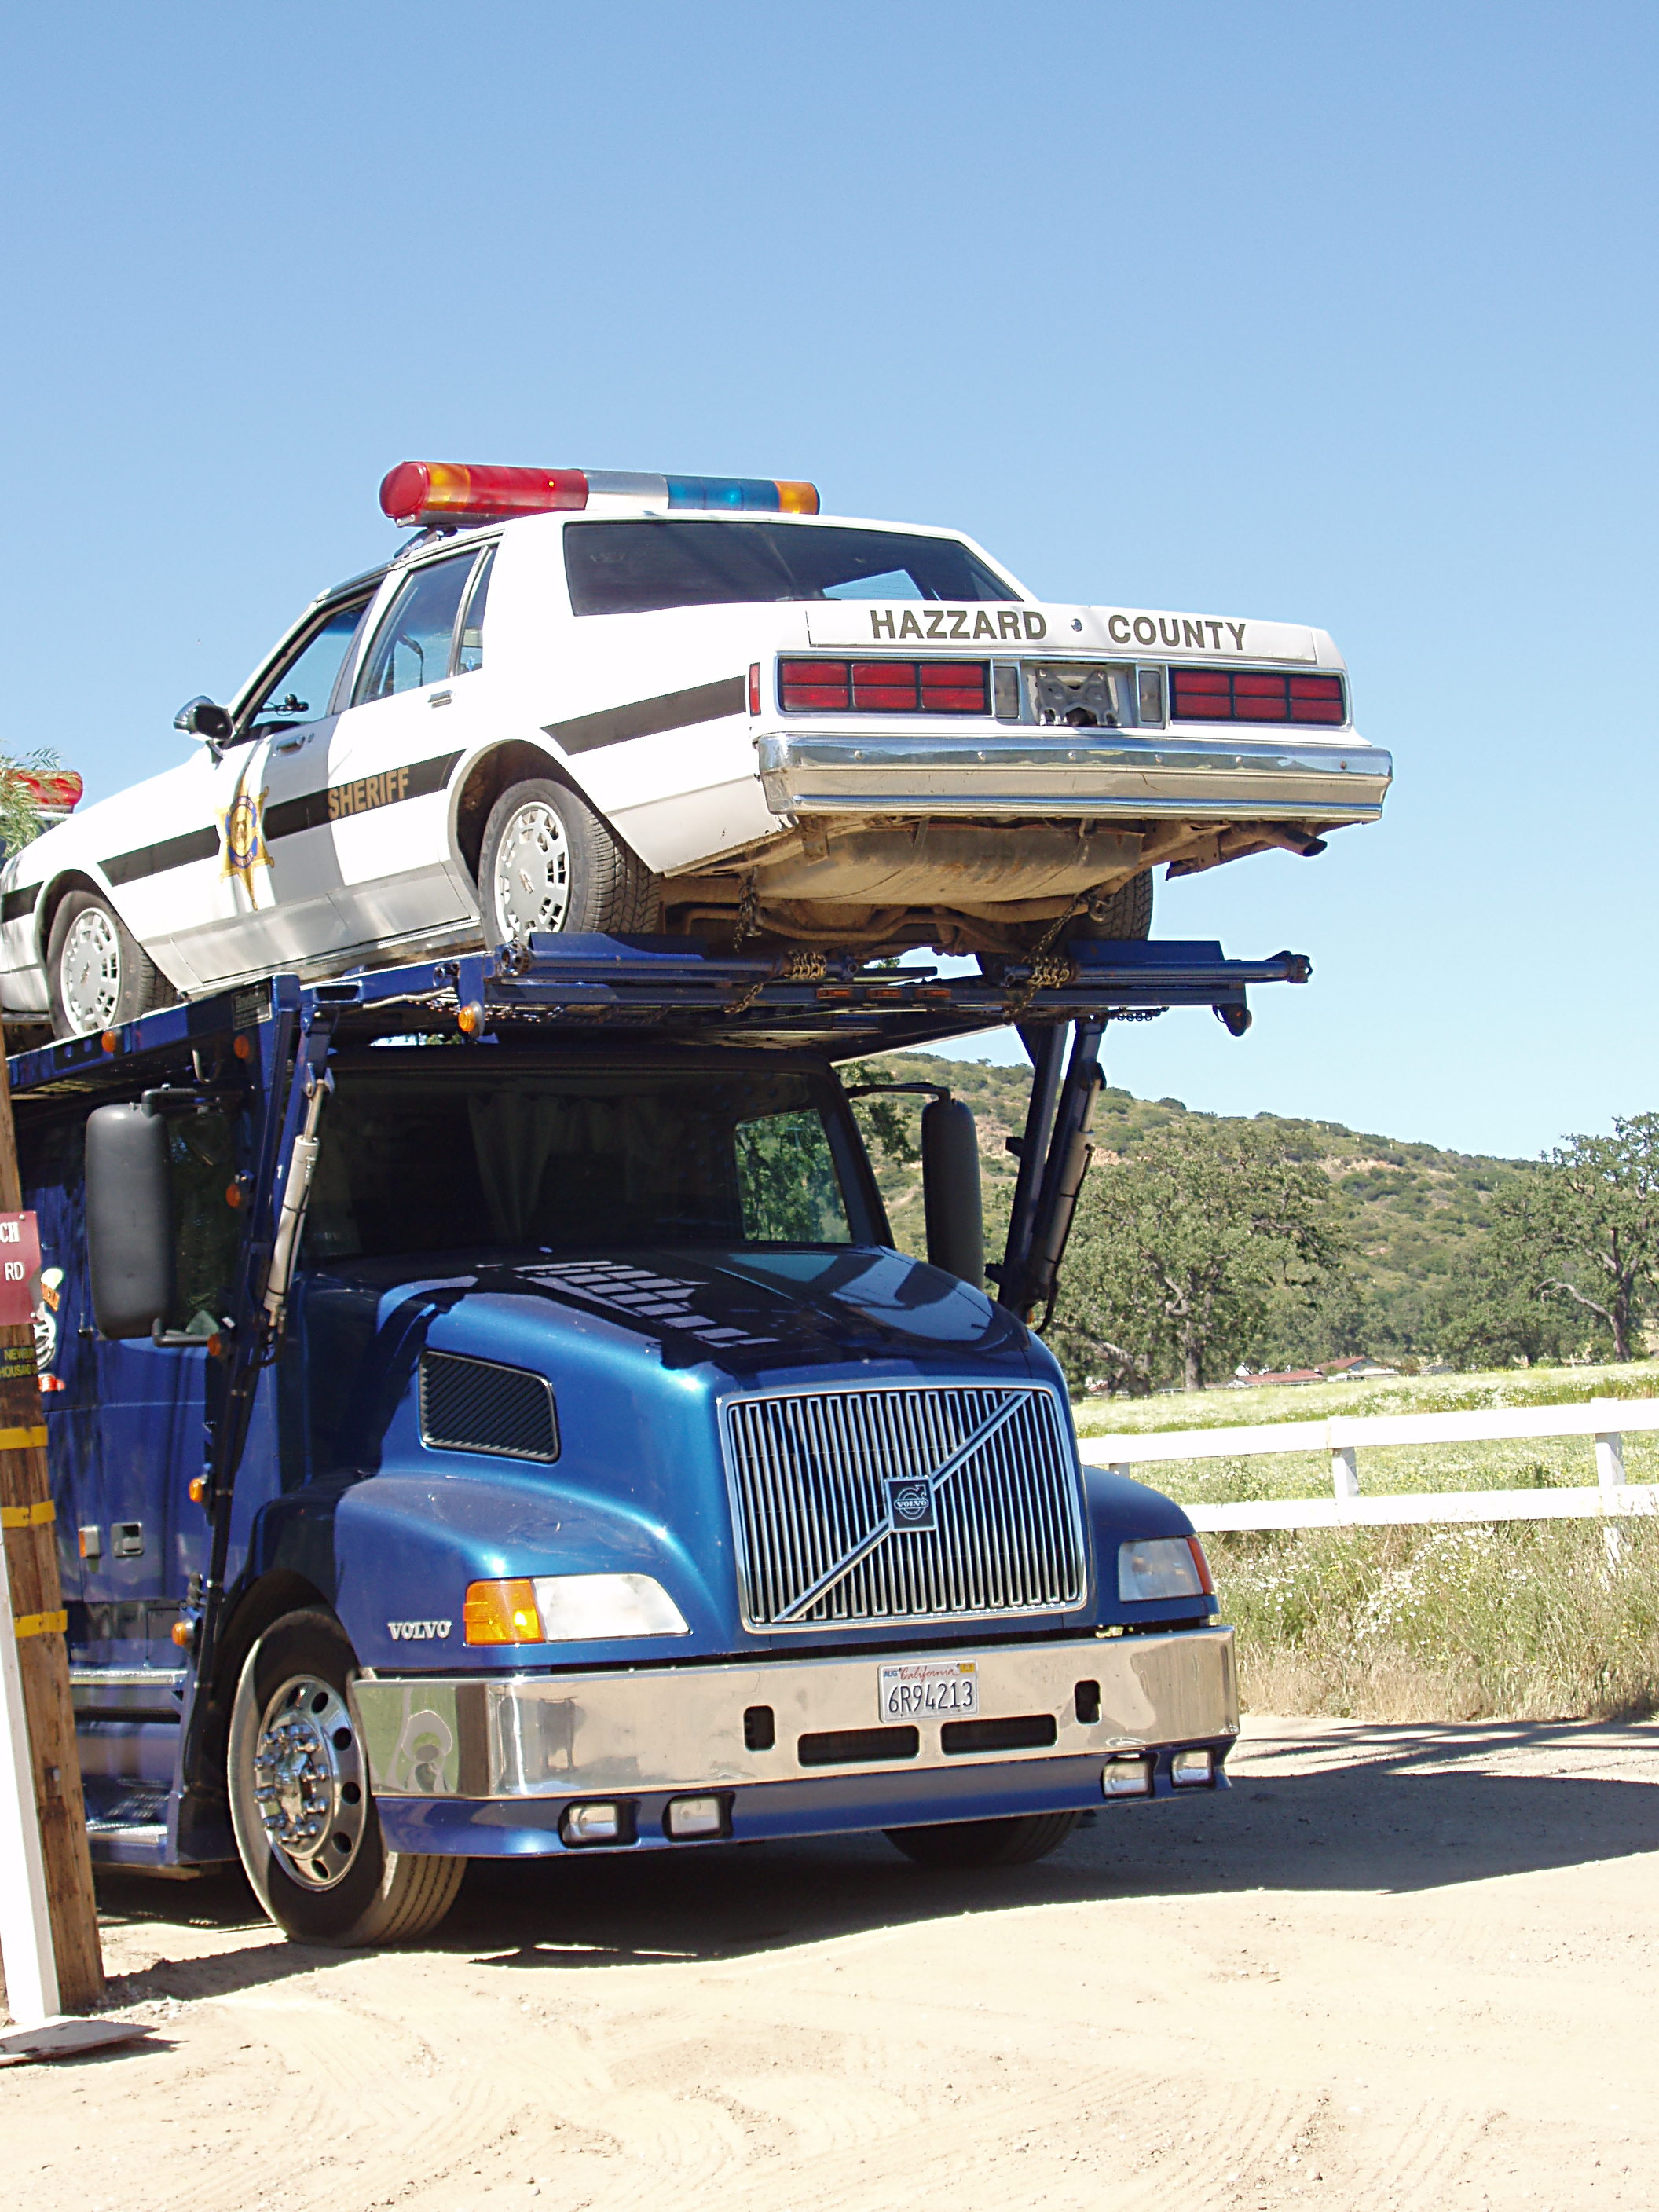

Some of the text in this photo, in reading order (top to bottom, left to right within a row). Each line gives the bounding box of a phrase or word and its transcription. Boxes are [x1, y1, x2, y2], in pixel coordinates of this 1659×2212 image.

[870, 610, 1246, 650] HAZZARD COUNTY
[328, 767, 409, 819] SHERIFF
[5, 1262, 24, 1281] RD
[388, 1621, 452, 1640] VOLVO
[900, 1666, 960, 1683] California
[888, 1681, 973, 1713] 6R94213
